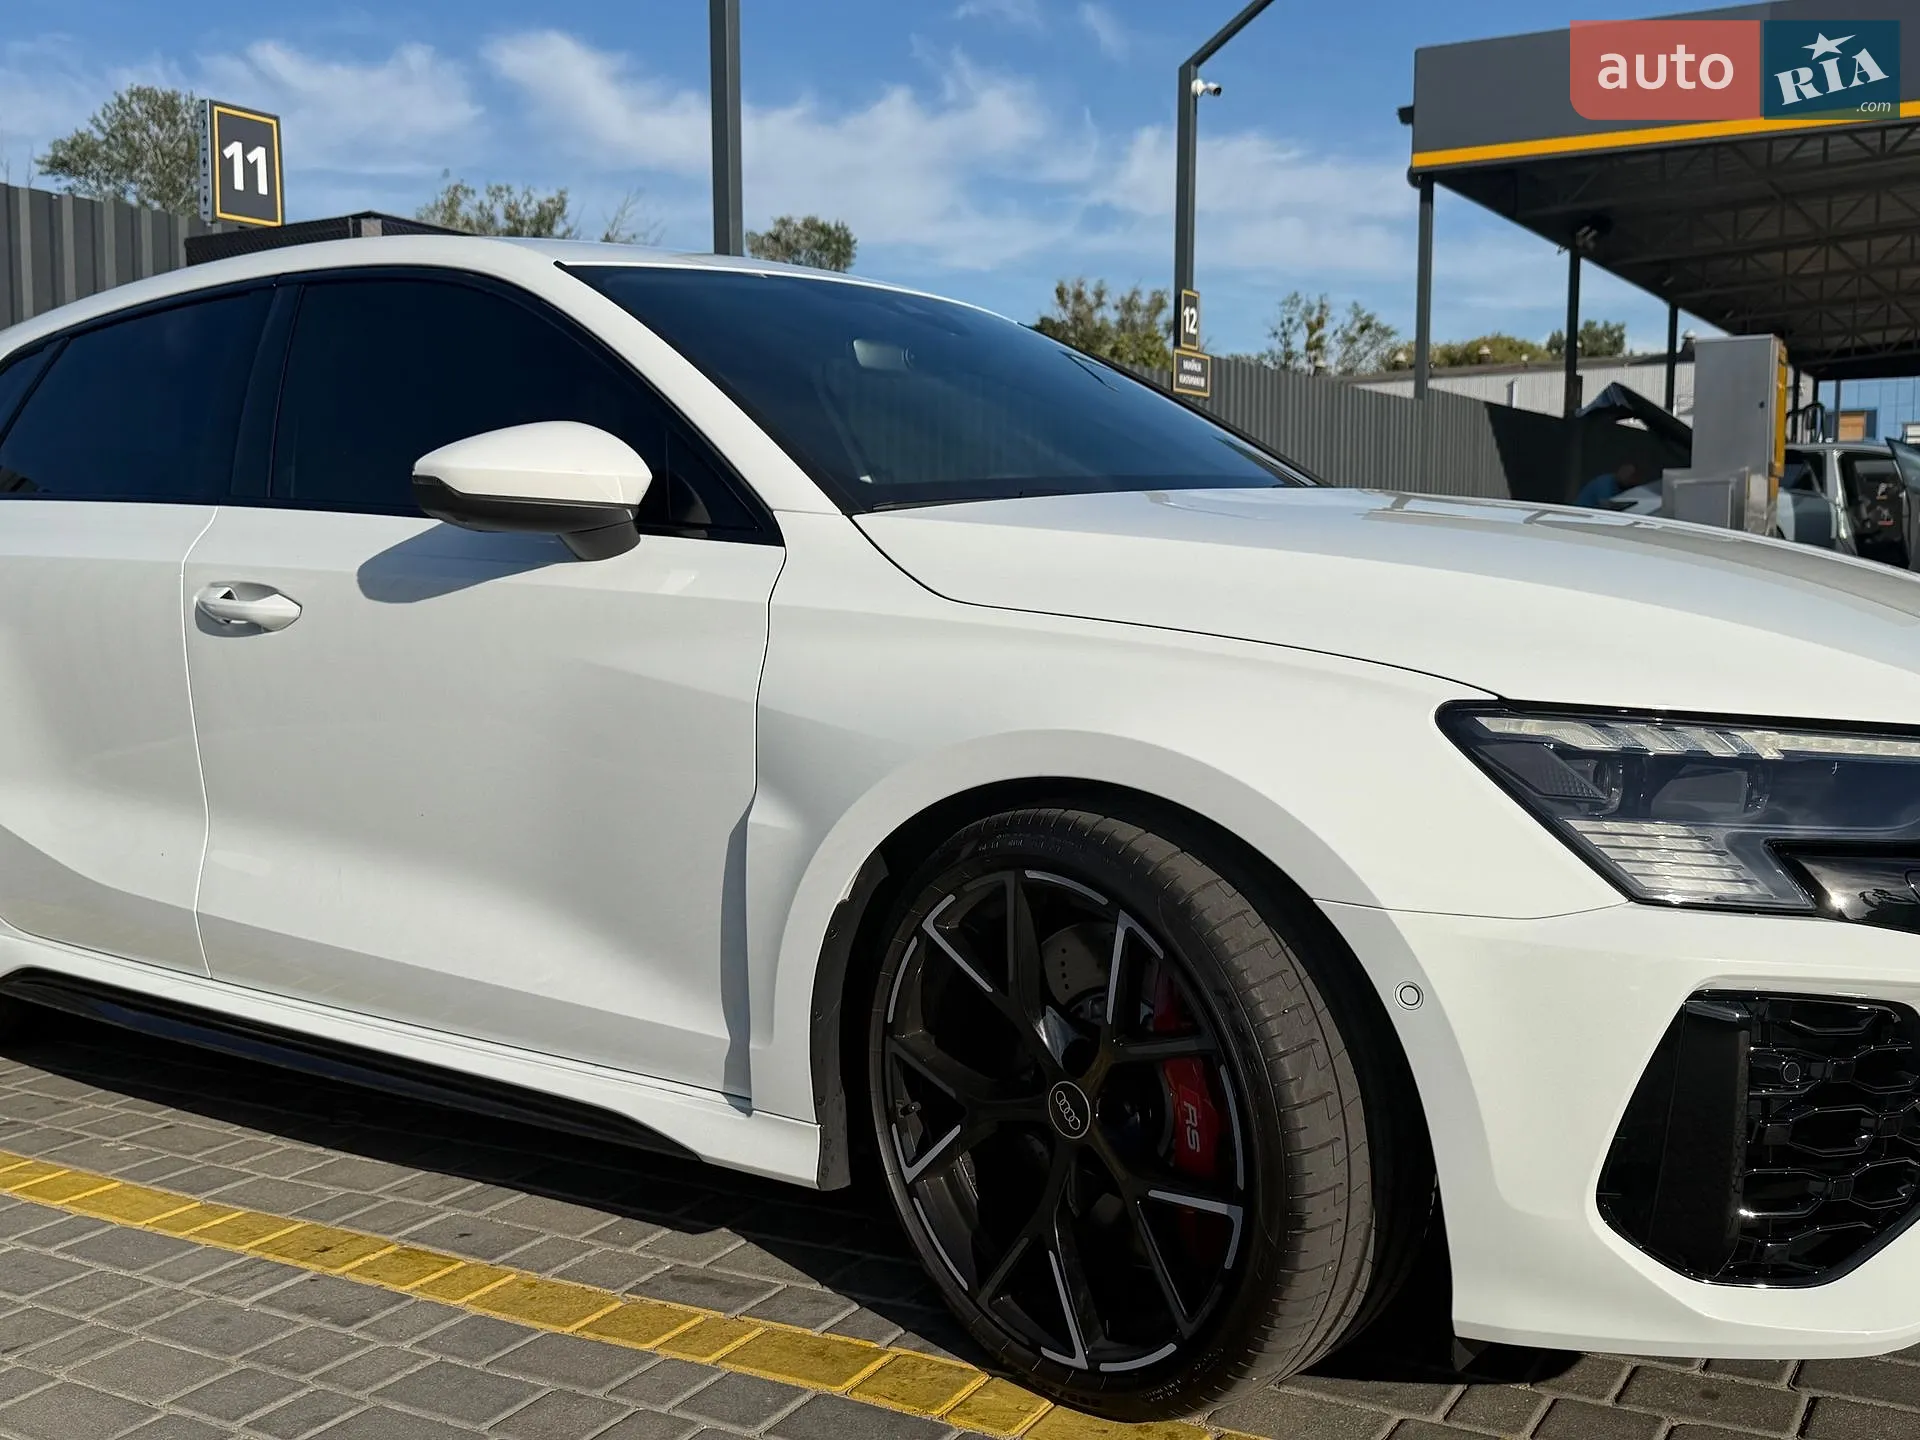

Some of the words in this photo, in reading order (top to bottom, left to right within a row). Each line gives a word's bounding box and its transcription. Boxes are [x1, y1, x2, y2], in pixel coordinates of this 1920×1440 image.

[222, 141, 268, 196] 11
[1183, 306, 1198, 335] 12
[1184, 1100, 1200, 1153] RS
